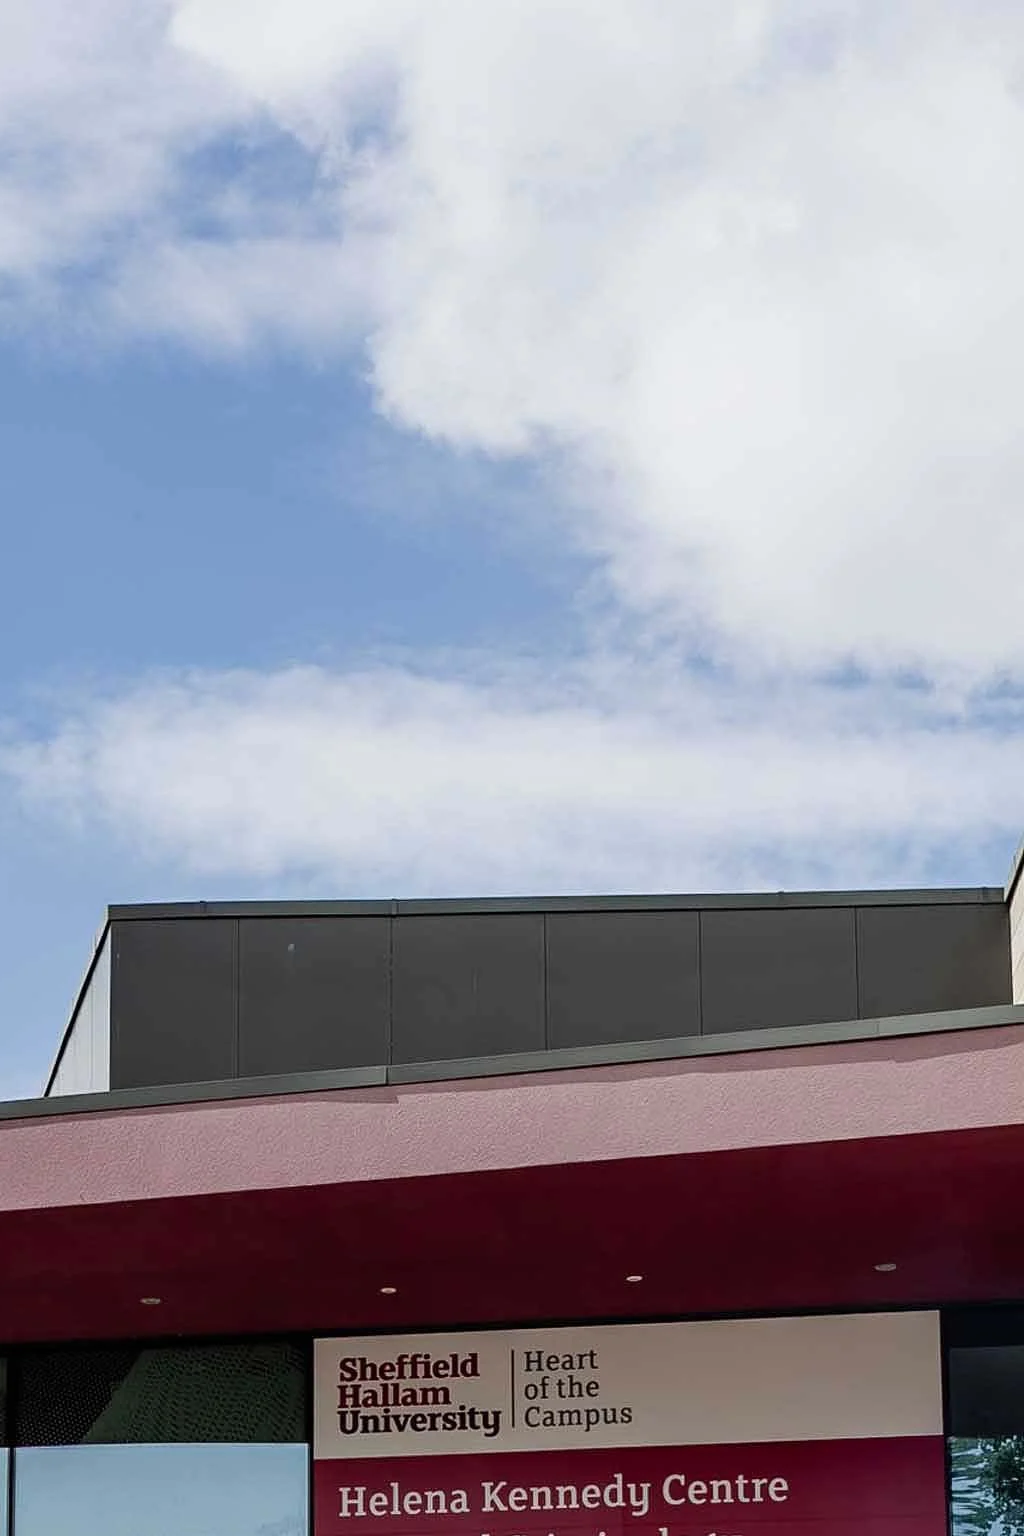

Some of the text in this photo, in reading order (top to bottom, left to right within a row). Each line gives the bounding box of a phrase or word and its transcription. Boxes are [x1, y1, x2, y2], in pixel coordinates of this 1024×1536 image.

[340, 1353, 480, 1382] Sheffield
[524, 1350, 598, 1372] Heart
[337, 1383, 451, 1408] Hallam
[525, 1375, 599, 1400] of the
[337, 1402, 502, 1437] University
[525, 1406, 632, 1432] Campus
[339, 1473, 788, 1516] Helena Kennedy Centre
